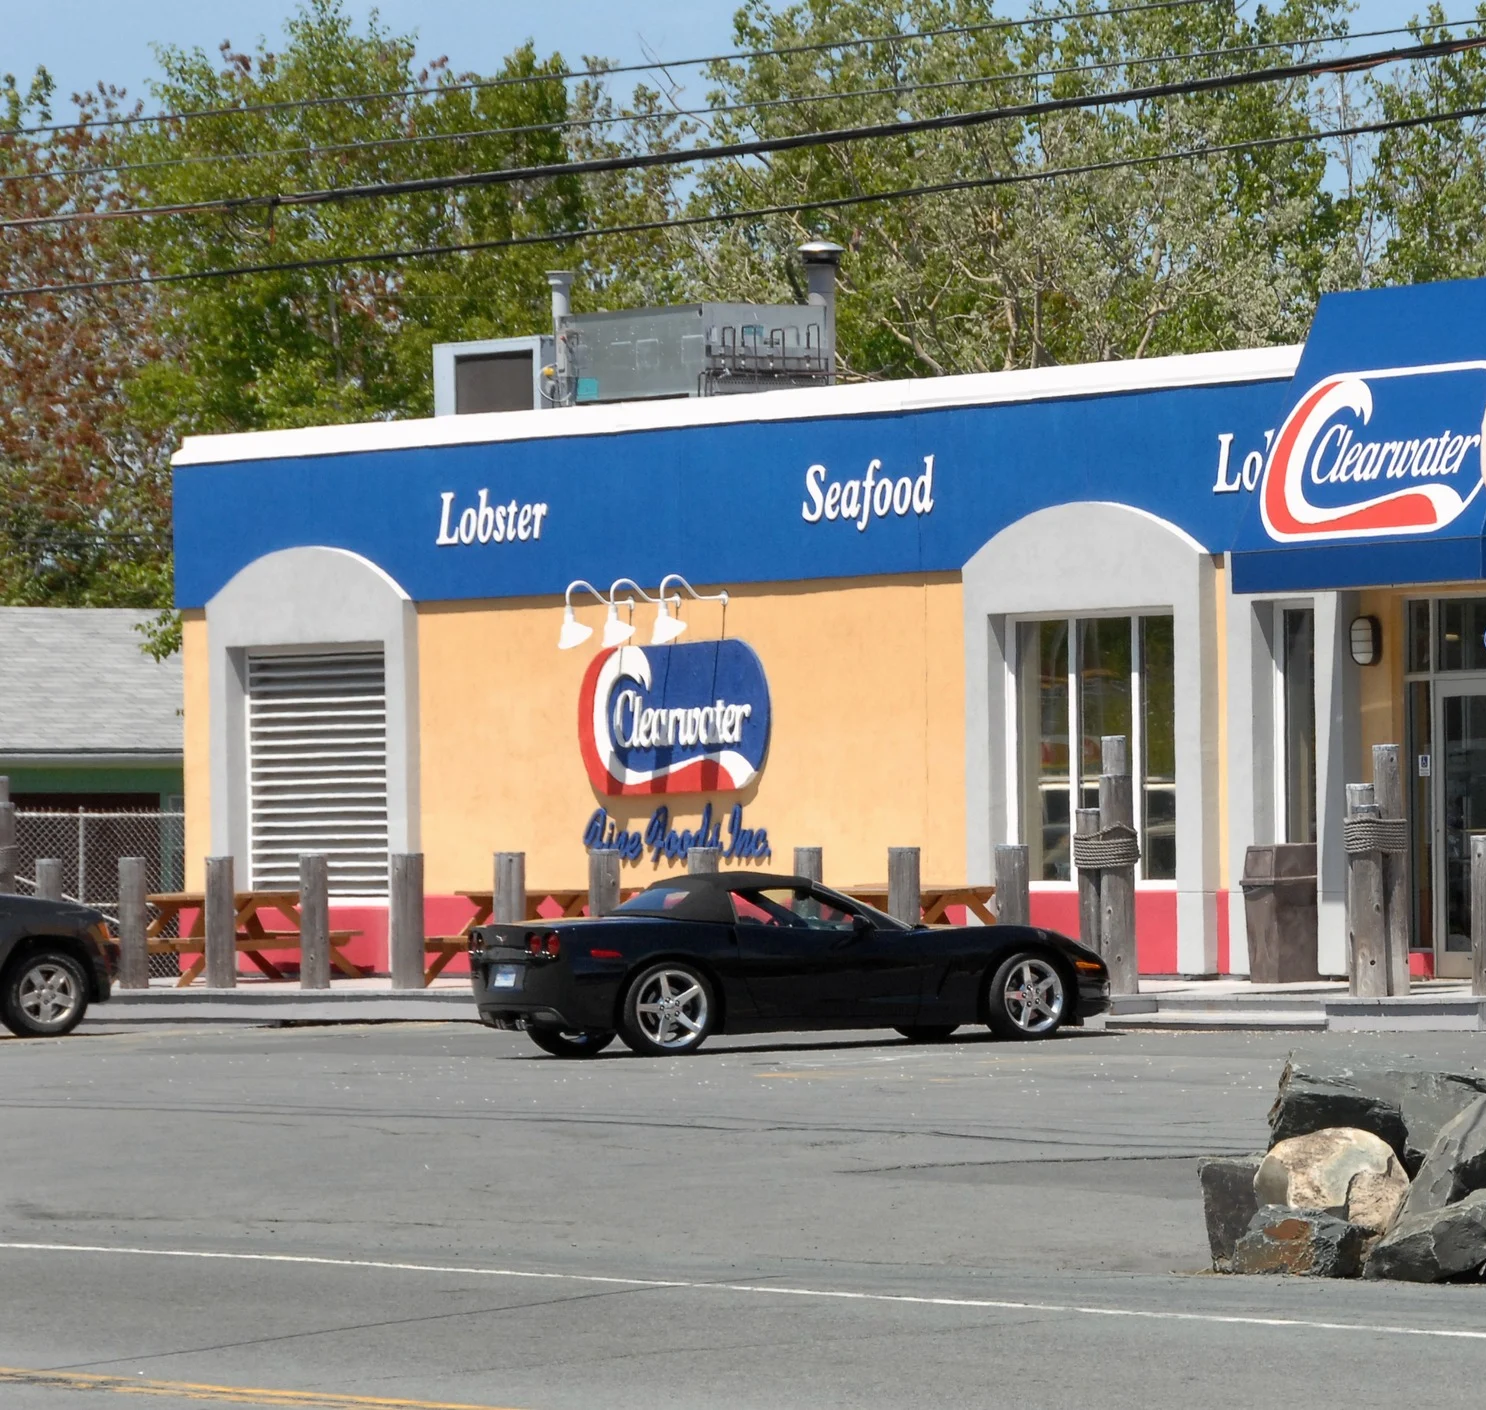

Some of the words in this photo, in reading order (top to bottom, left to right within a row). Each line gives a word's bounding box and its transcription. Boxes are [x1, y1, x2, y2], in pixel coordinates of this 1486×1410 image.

[1213, 428, 1275, 492] Lo
[1311, 424, 1481, 484] Clearwater
[436, 488, 547, 545] Lobster
[802, 455, 934, 531] Seafood
[613, 690, 752, 748] Clearwater
[583, 807, 643, 860] Fine
[645, 803, 724, 863] Foods
[722, 803, 771, 858] Inc.
